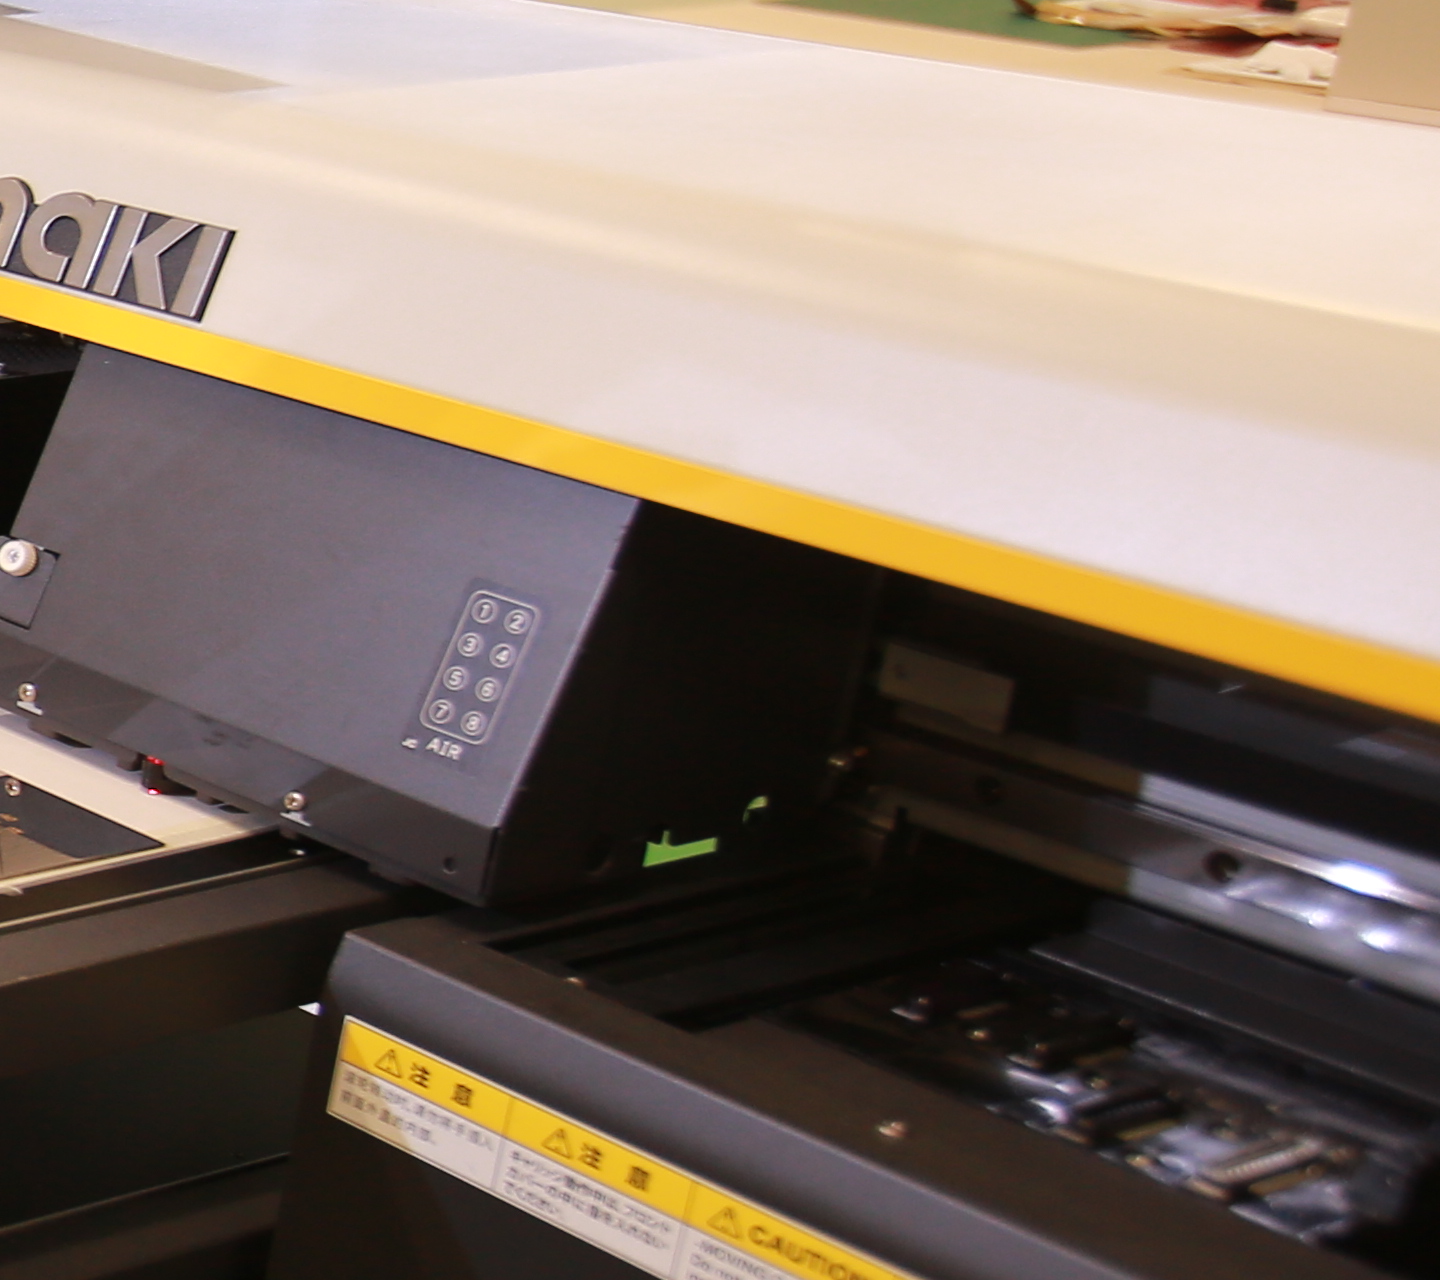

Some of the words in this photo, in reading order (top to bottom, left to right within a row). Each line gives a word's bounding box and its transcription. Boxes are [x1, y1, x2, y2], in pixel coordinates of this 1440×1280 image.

[425, 737, 463, 761] AIR
[407, 1060, 474, 1109] 注意
[578, 1139, 652, 1193] 注意
